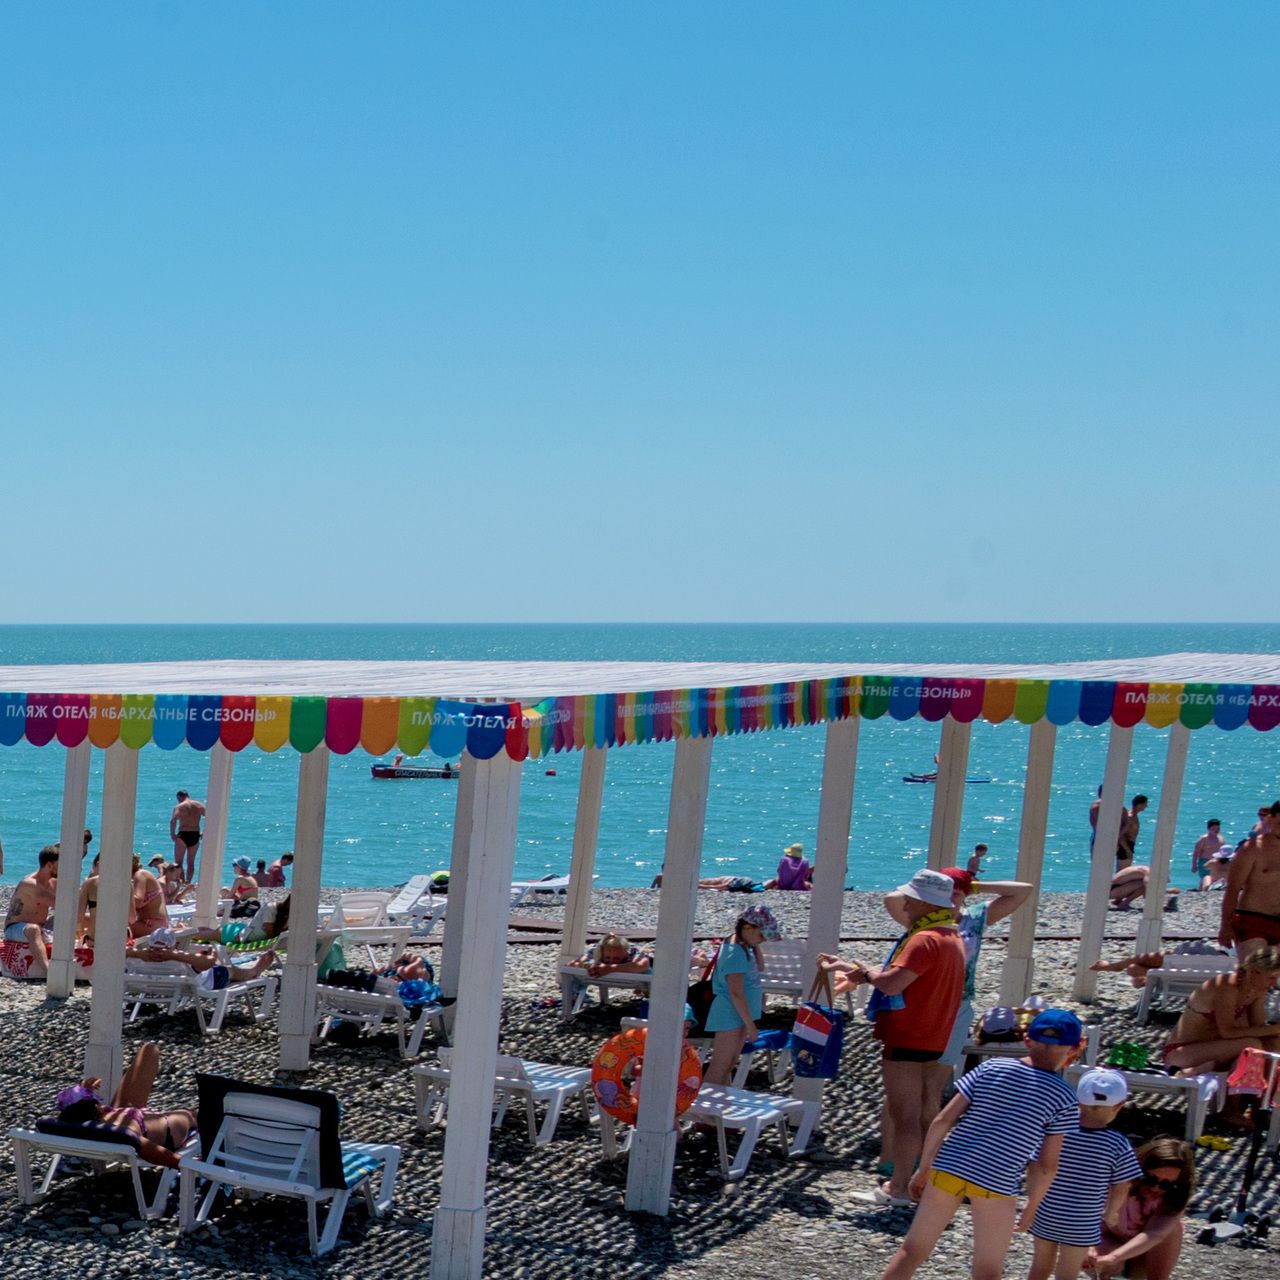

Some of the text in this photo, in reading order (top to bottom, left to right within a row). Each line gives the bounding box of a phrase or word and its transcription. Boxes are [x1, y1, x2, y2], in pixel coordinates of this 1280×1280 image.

[903, 686, 972, 699] СЕЗОНЫ»
[1125, 692, 1280, 707] ПЛЯЖ ОТЕЛЯ «БАРХ
[6, 704, 276, 722] ПЛЯЖ ОТЕЛЯ «БАРХАТНЫЕ СЕЗОНЫ»
[411, 711, 456, 726] ПЛЯЖ
[463, 714, 517, 729] ОТЕЛЯ
